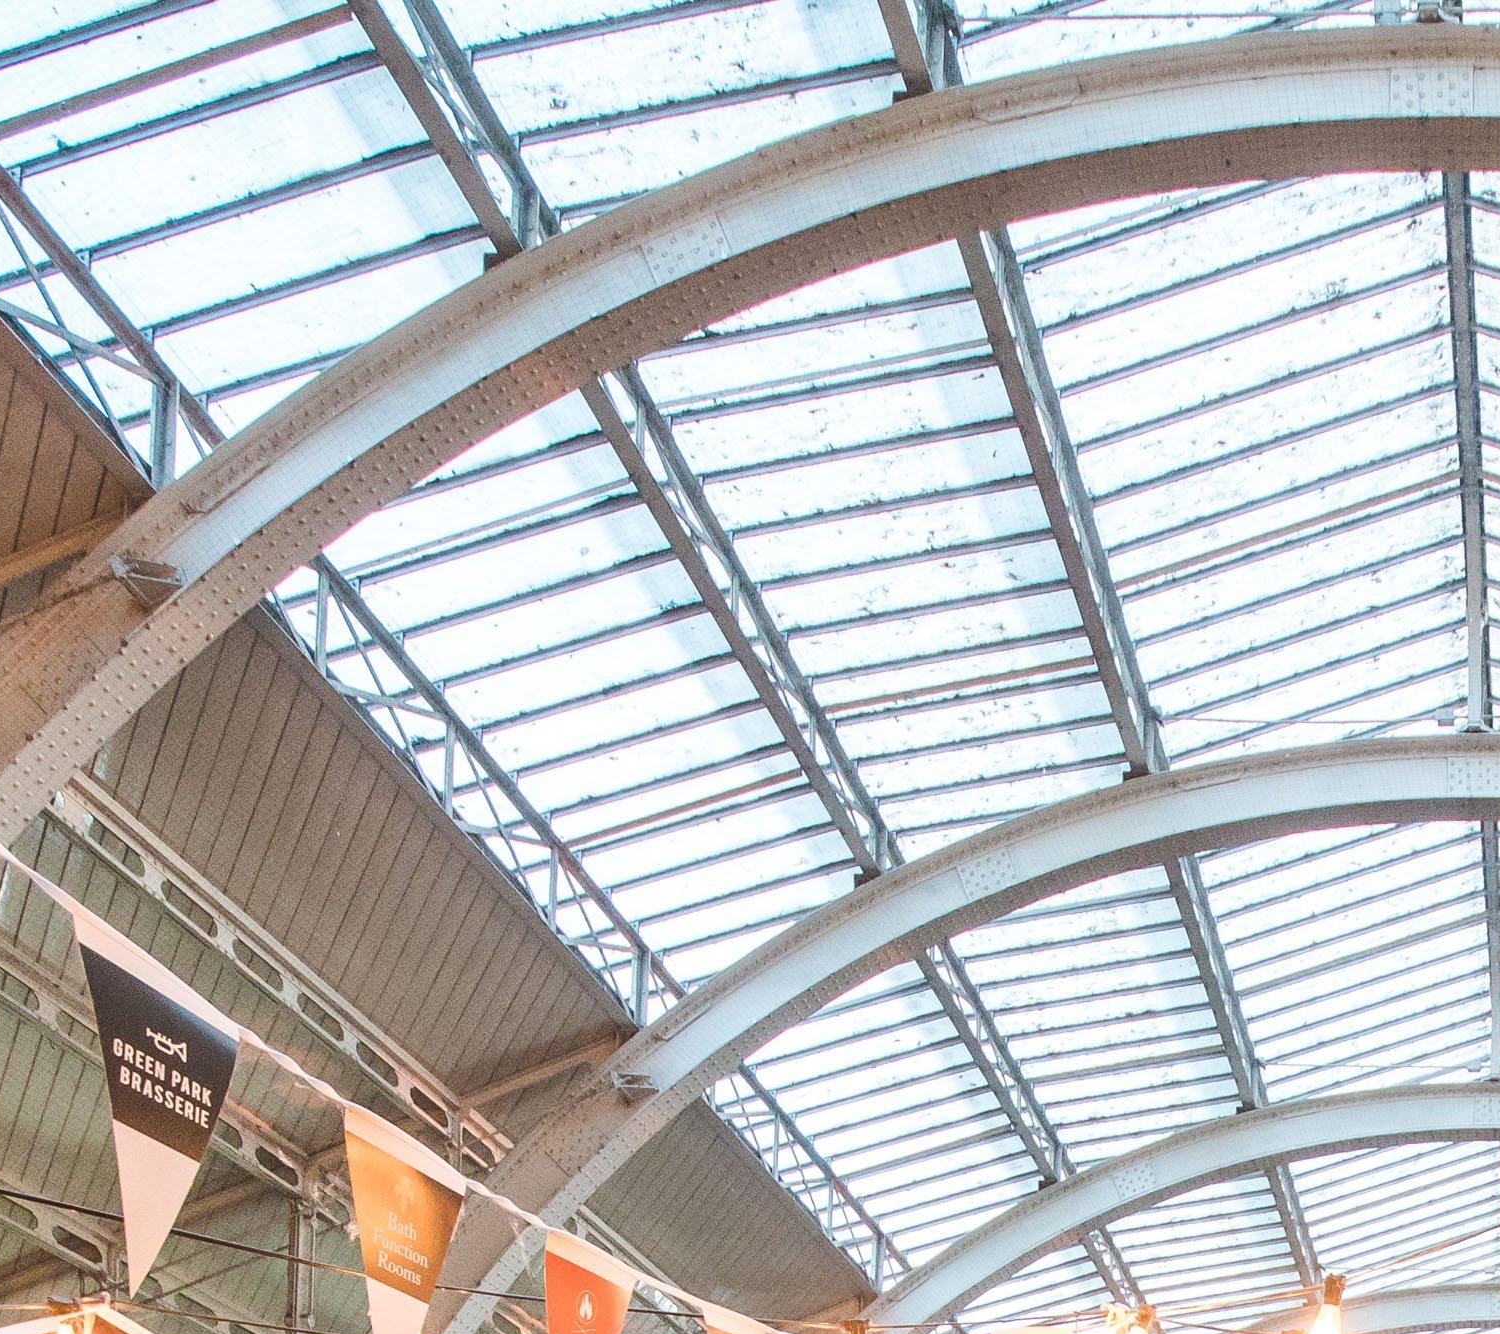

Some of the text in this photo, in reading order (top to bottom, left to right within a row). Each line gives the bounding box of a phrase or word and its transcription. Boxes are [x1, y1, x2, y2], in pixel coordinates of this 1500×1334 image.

[113, 1038, 212, 1107] GREEN PARK
[120, 1065, 210, 1129] BRASSERIE
[373, 1226, 429, 1268] Function
[388, 1211, 416, 1241] Bath
[377, 1250, 421, 1285] Rooms
